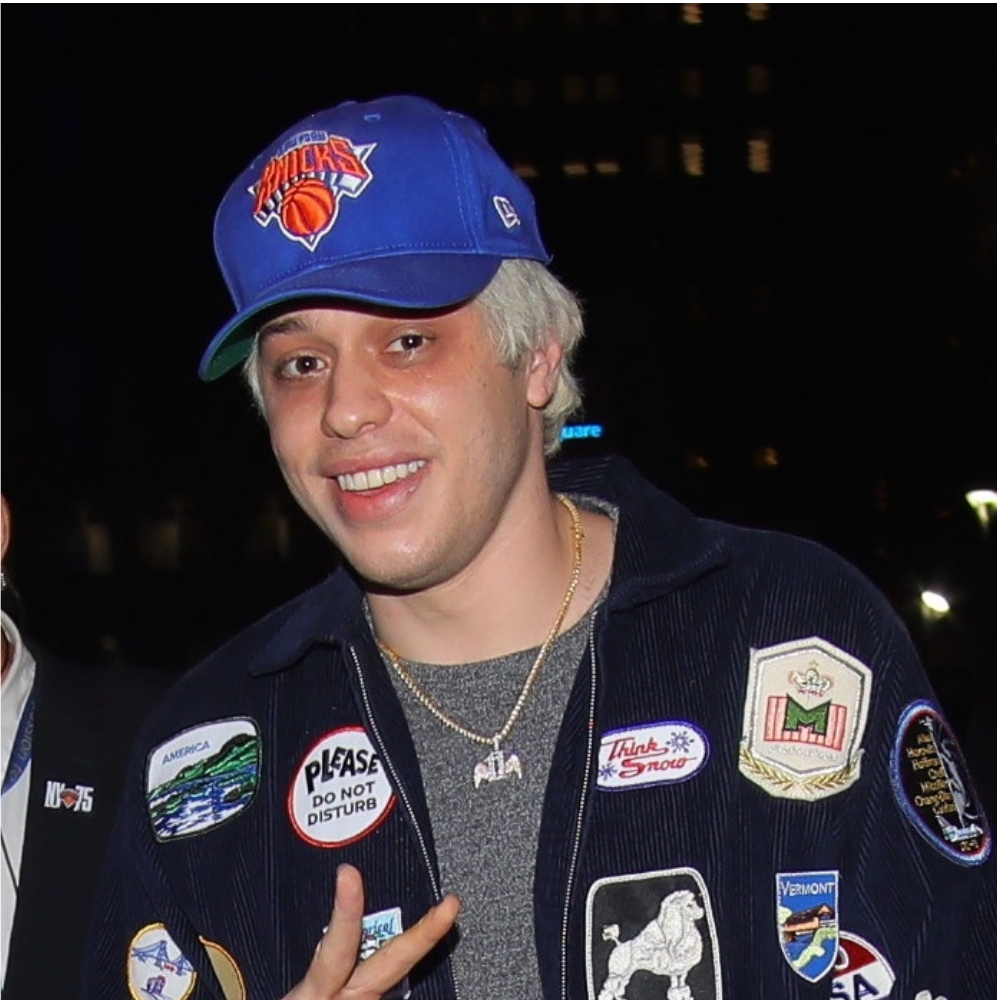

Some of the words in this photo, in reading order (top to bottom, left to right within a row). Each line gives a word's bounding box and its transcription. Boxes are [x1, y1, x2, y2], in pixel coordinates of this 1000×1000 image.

[253, 136, 369, 215] KNICKS
[162, 741, 211, 765] AMERICA
[601, 736, 669, 761] Think
[305, 746, 380, 796] PLEASE
[619, 758, 697, 779] Snow
[44, 780, 65, 809] NY
[73, 785, 94, 812] 75
[312, 792, 336, 808] DO
[341, 781, 375, 801] NOT
[308, 797, 377, 827] DISTURB
[780, 881, 835, 897] VERMONT
